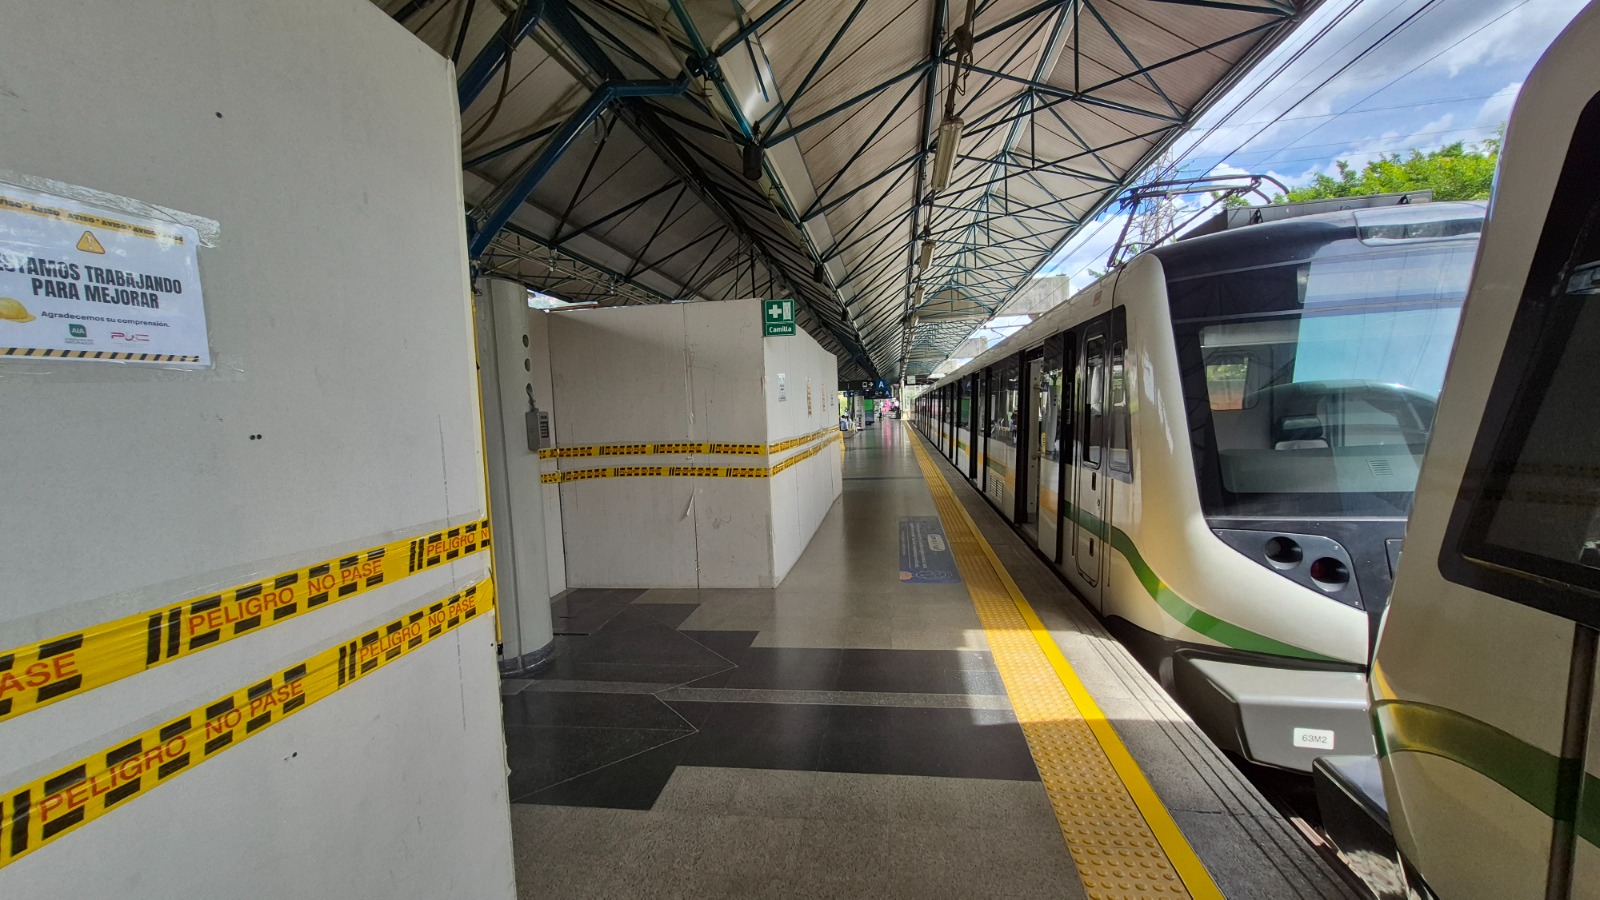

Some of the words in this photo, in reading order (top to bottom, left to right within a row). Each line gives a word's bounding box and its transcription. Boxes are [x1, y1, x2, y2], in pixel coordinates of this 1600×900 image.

[68, 213, 95, 223] AVISO
[101, 220, 127, 230] AVISO
[84, 265, 182, 294] TRABAJANDO
[31, 277, 80, 301] PARA
[84, 284, 160, 309] MEJORAR
[41, 311, 104, 322] Agradecemos
[769, 325, 792, 333] Camilla
[188, 588, 294, 636] PELIGRO
[307, 574, 336, 596] NO
[341, 559, 382, 585] PASE
[427, 533, 475, 556] PELIGRO
[38, 735, 187, 823] PELIGRO
[205, 708, 242, 740] NO
[249, 679, 304, 719] PASE
[359, 622, 421, 663] PELIGRO
[428, 610, 446, 627] NO
[448, 596, 475, 619] PASE
[1302, 735, 1328, 743] 63M2
